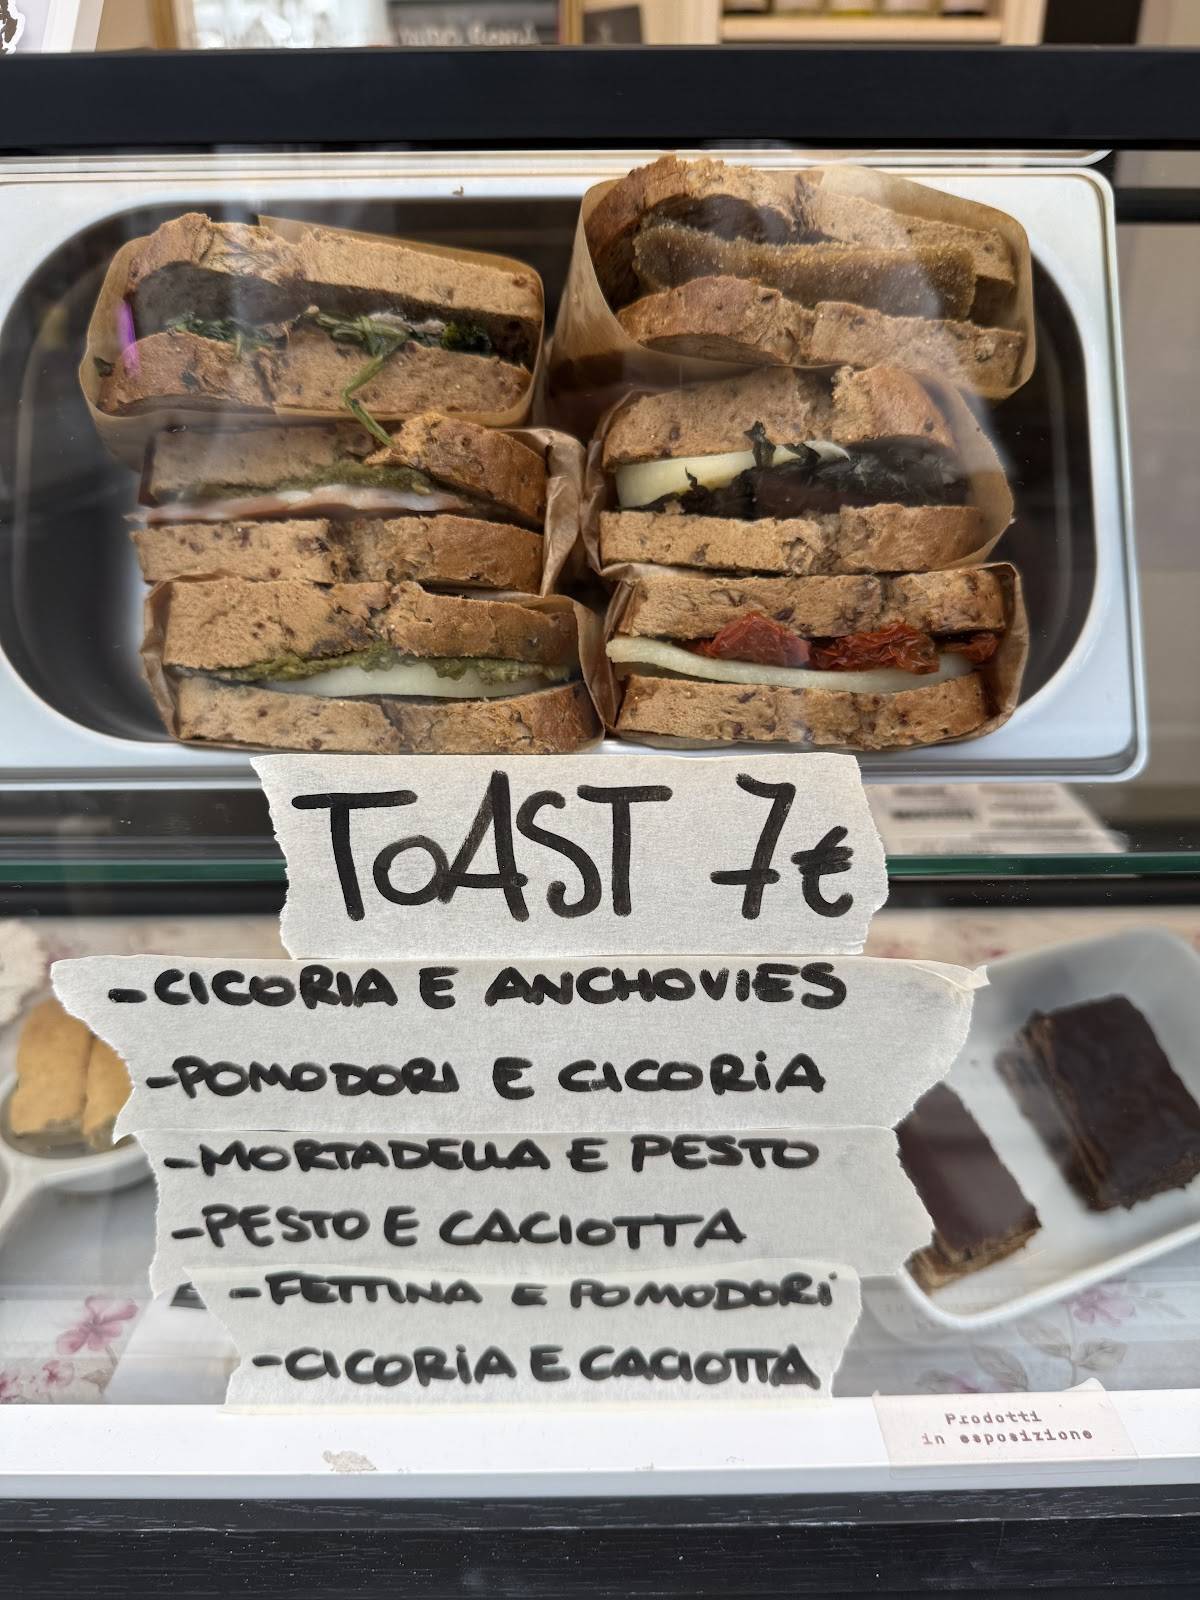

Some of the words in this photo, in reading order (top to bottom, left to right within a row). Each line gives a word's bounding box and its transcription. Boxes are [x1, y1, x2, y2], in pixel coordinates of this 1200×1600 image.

[419, 966, 459, 1009] E
[485, 962, 847, 1010] ANCHOVIES
[492, 1056, 535, 1100] E
[566, 1137, 608, 1172] E
[631, 1134, 819, 1172] PESTO
[384, 1206, 419, 1246] E
[439, 1207, 747, 1250] CACIOTTA
[512, 1282, 547, 1306] E
[530, 1344, 570, 1382] E
[580, 1344, 820, 1390] CACIOTTA
[922, 1432, 945, 1445] in
[959, 1428, 1093, 1446] esposizione
[945, 1410, 1042, 1425] Prodotti
